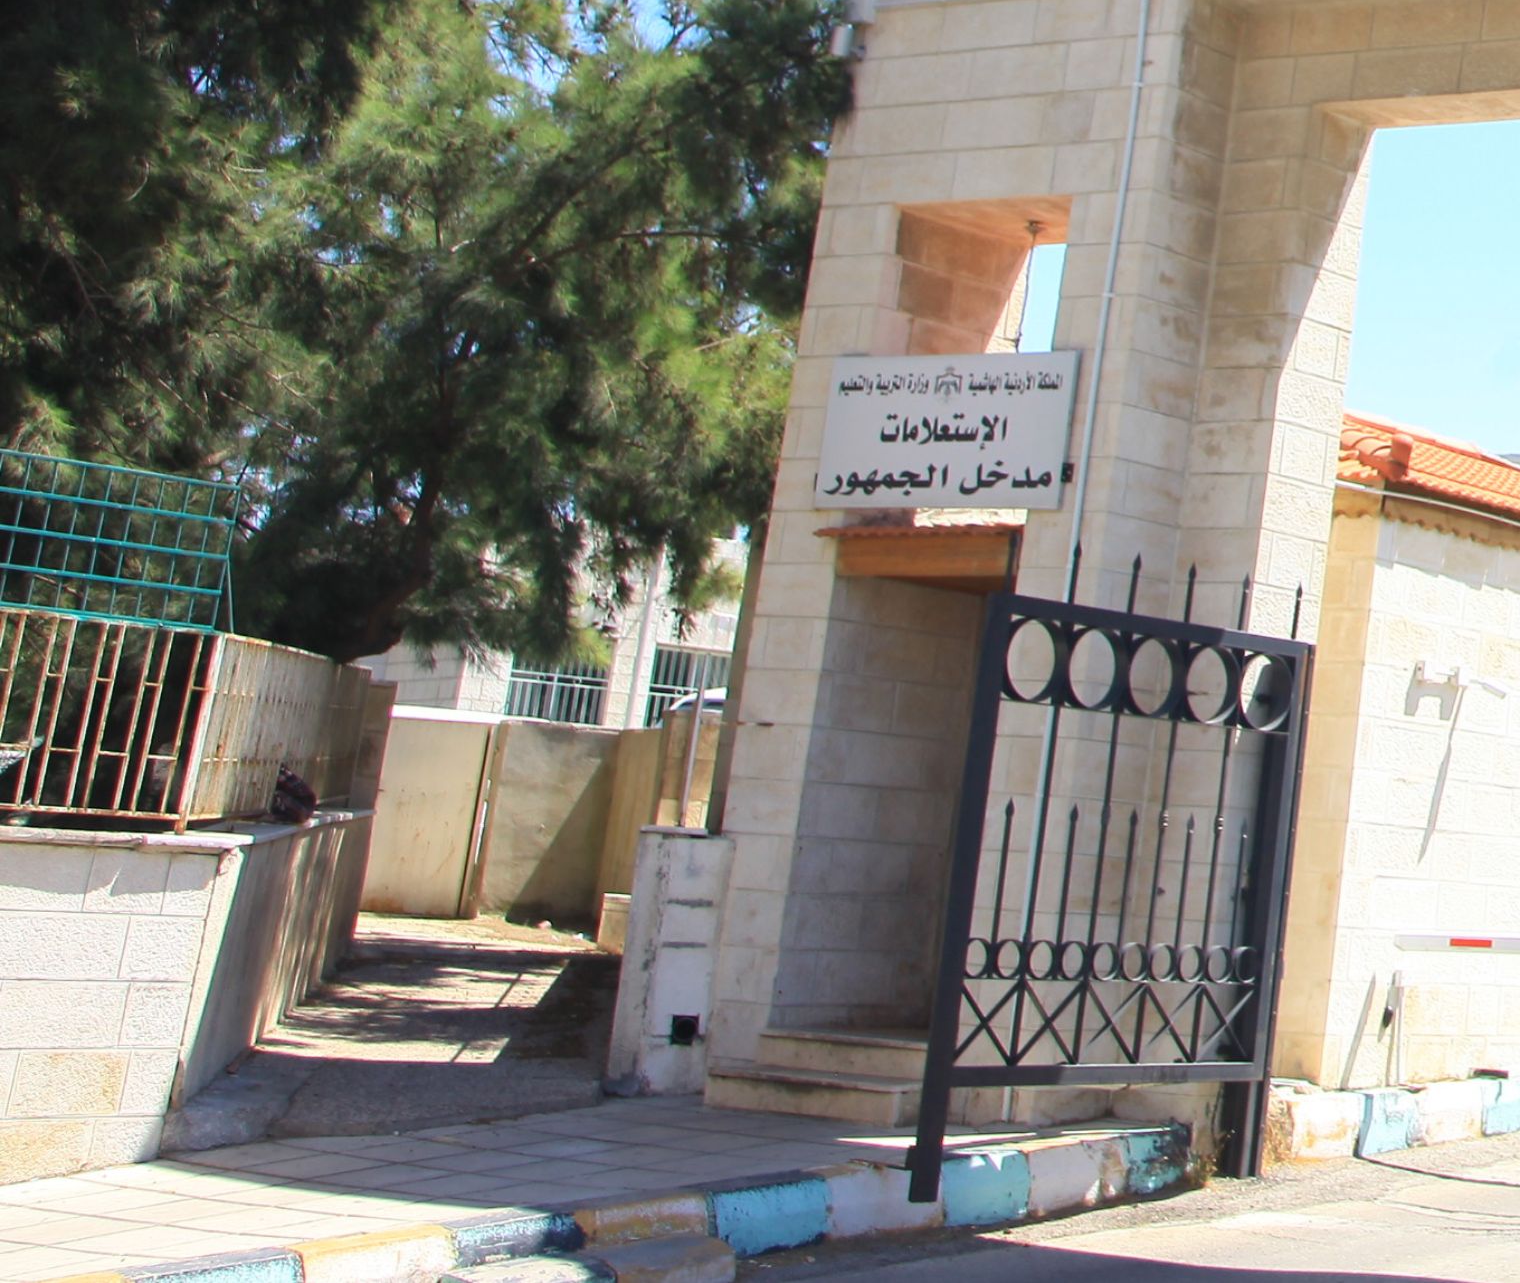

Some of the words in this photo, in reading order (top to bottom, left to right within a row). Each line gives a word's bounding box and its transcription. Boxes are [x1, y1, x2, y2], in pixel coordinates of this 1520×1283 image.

[837, 373, 874, 397] والتعليم
[875, 372, 907, 397] التربية
[906, 373, 930, 396] وزارة
[879, 413, 1008, 450] الإستعلامات
[823, 463, 949, 497] الجمهور
[958, 459, 1052, 496] مدخل
